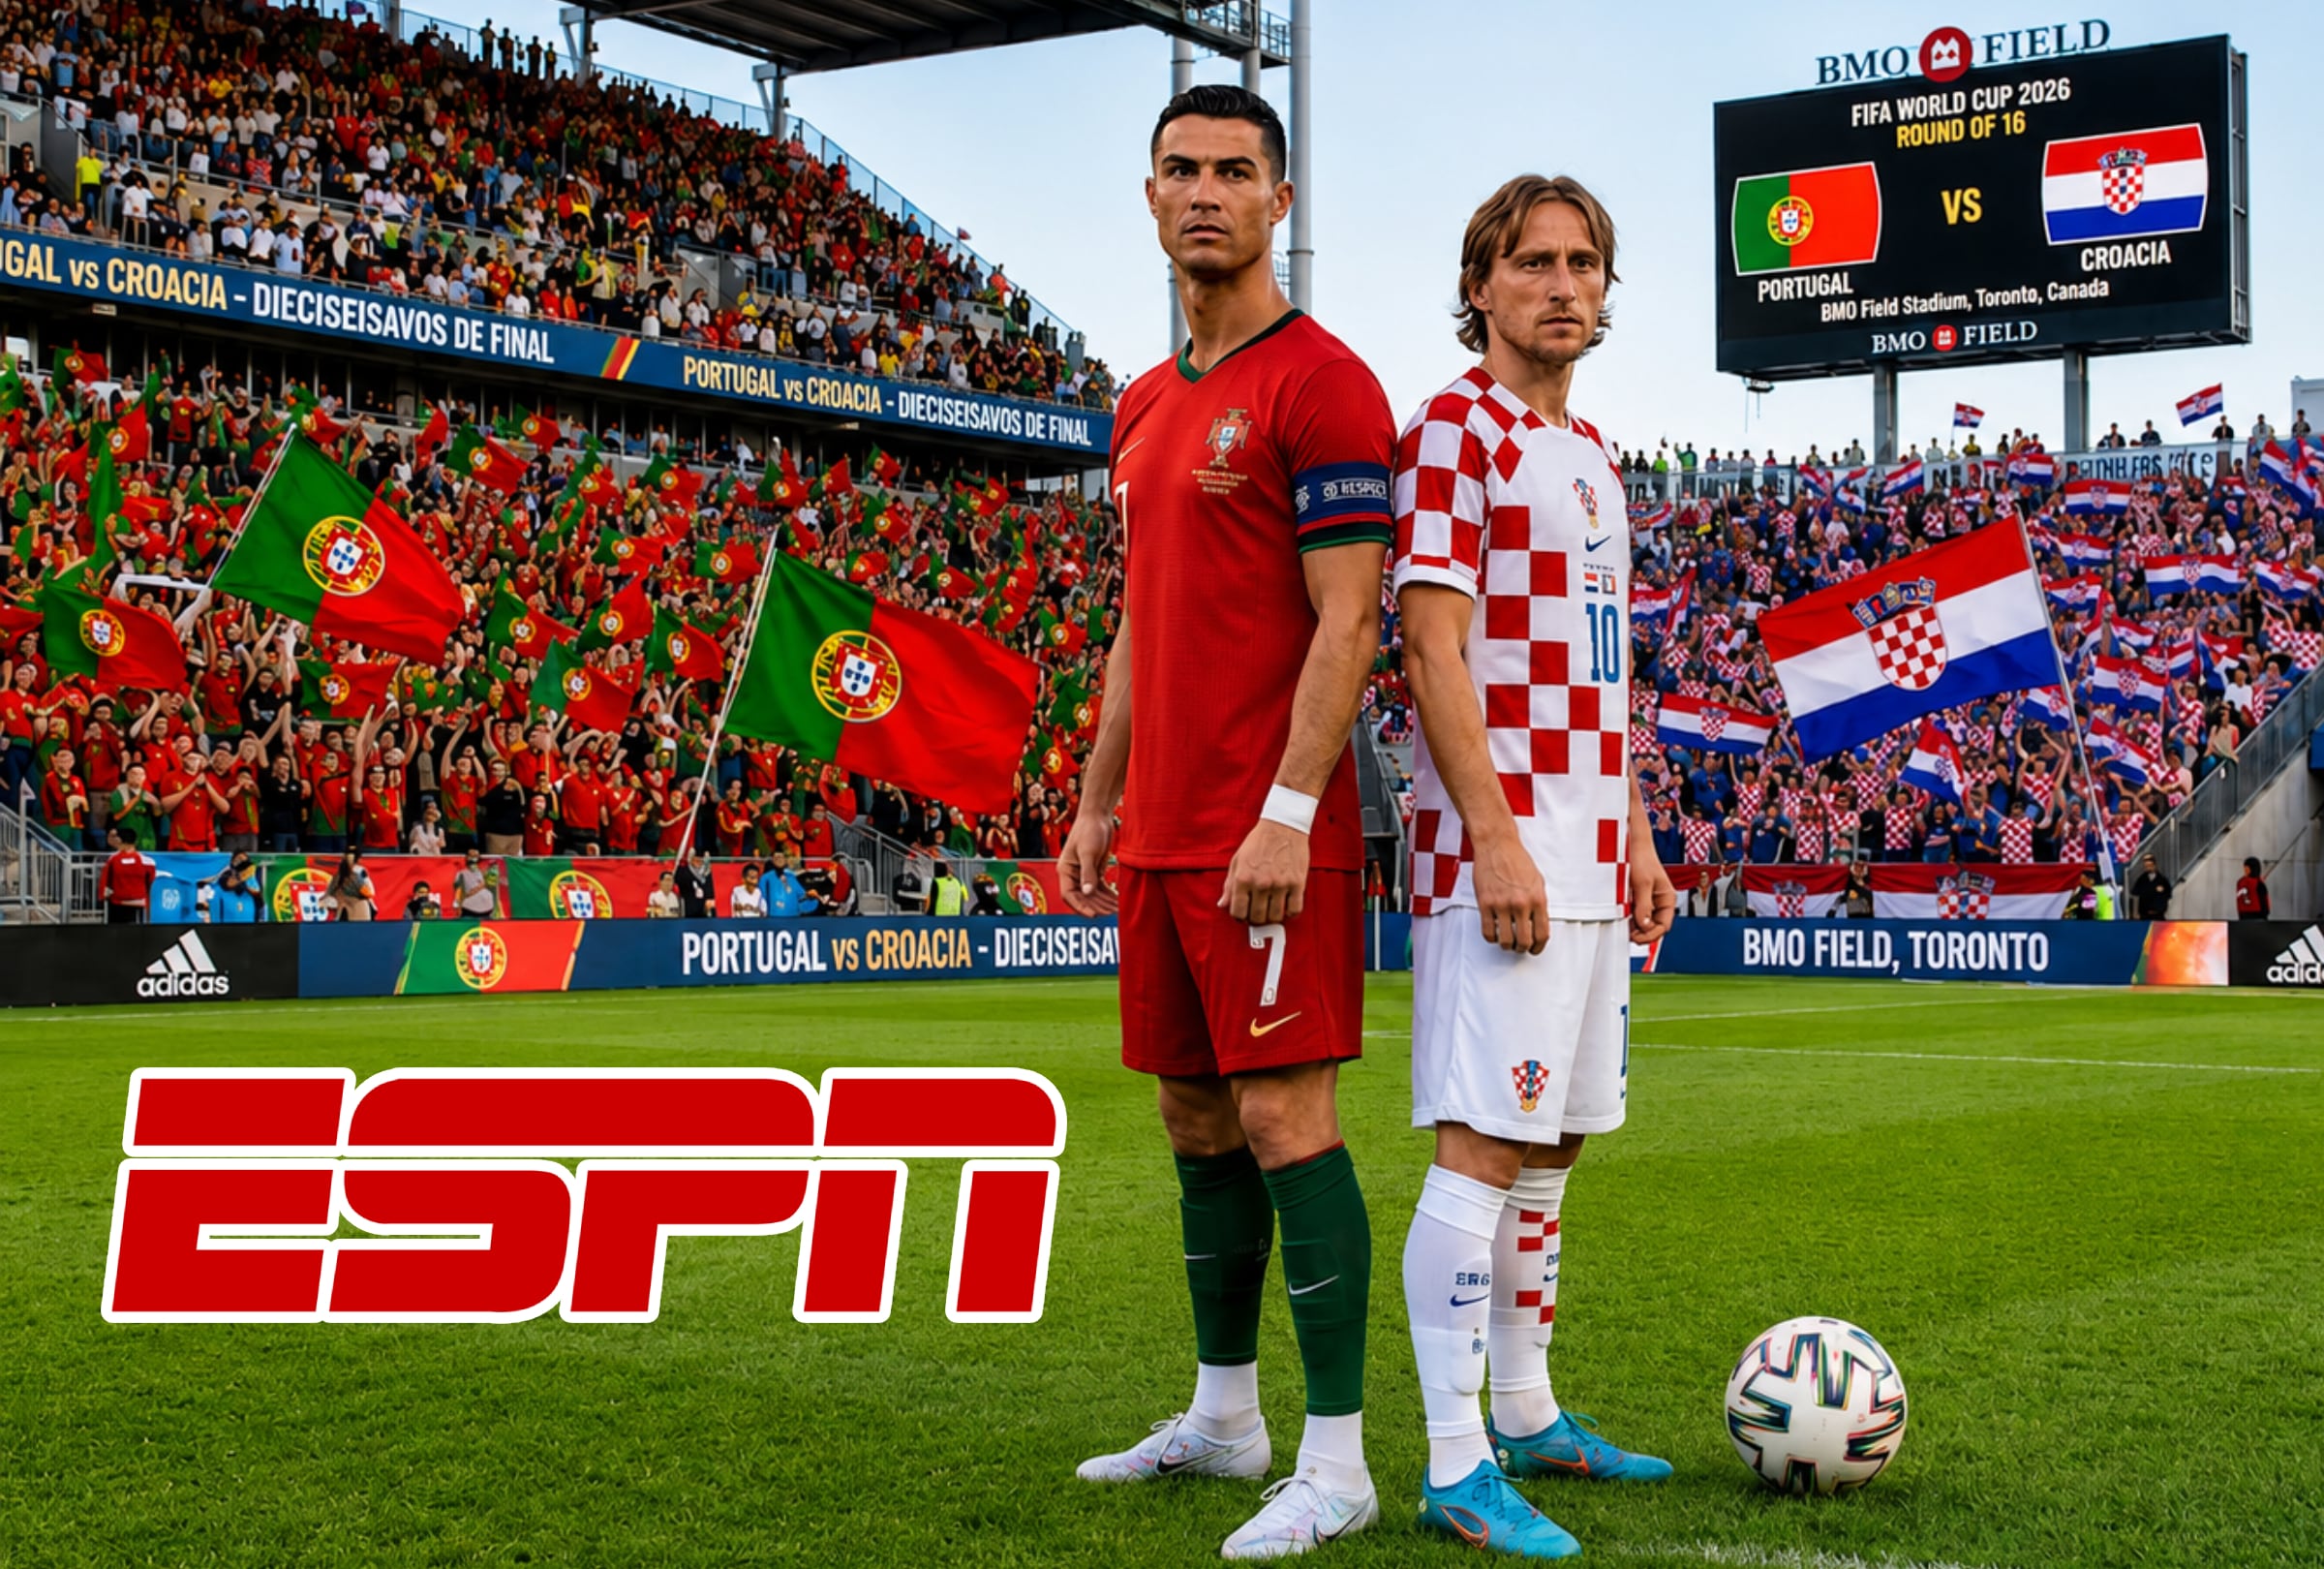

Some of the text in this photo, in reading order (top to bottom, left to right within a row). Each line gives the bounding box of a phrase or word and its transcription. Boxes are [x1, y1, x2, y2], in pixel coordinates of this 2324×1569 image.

[1816, 18, 2111, 84] BMO FIELD
[1851, 77, 2071, 127] FIFA WORLD CUP 2026
[1897, 110, 2027, 148] ROUND OF 16
[1941, 187, 1983, 225] VS
[2081, 240, 2172, 271] CROACIA
[0, 238, 62, 284] GAL
[107, 258, 228, 310] CROACIA
[253, 282, 447, 346] DIECISEISAVOS
[454, 317, 484, 353] DE
[490, 323, 555, 364] FINAL
[1758, 271, 1854, 303] PORTUGAL
[1820, 278, 2110, 323] BMO Field Stadium, Toronto, Canada
[1872, 321, 2038, 354] BMO FIELD
[684, 355, 781, 399] PORTUGAL
[807, 377, 882, 414] CROACIA
[899, 391, 1022, 435] DIECISEISAVOS
[1025, 412, 1045, 439] DE
[1049, 415, 1092, 446] FINAL
[1585, 602, 1620, 684] 10
[682, 930, 827, 975] PORTUGAL
[866, 928, 972, 969] CROACIA
[1249, 923, 1287, 1006] 7
[1743, 928, 2049, 975] BMO FIELD, TORONTO
[2267, 962, 2324, 983] adid
[137, 971, 230, 997] adidas
